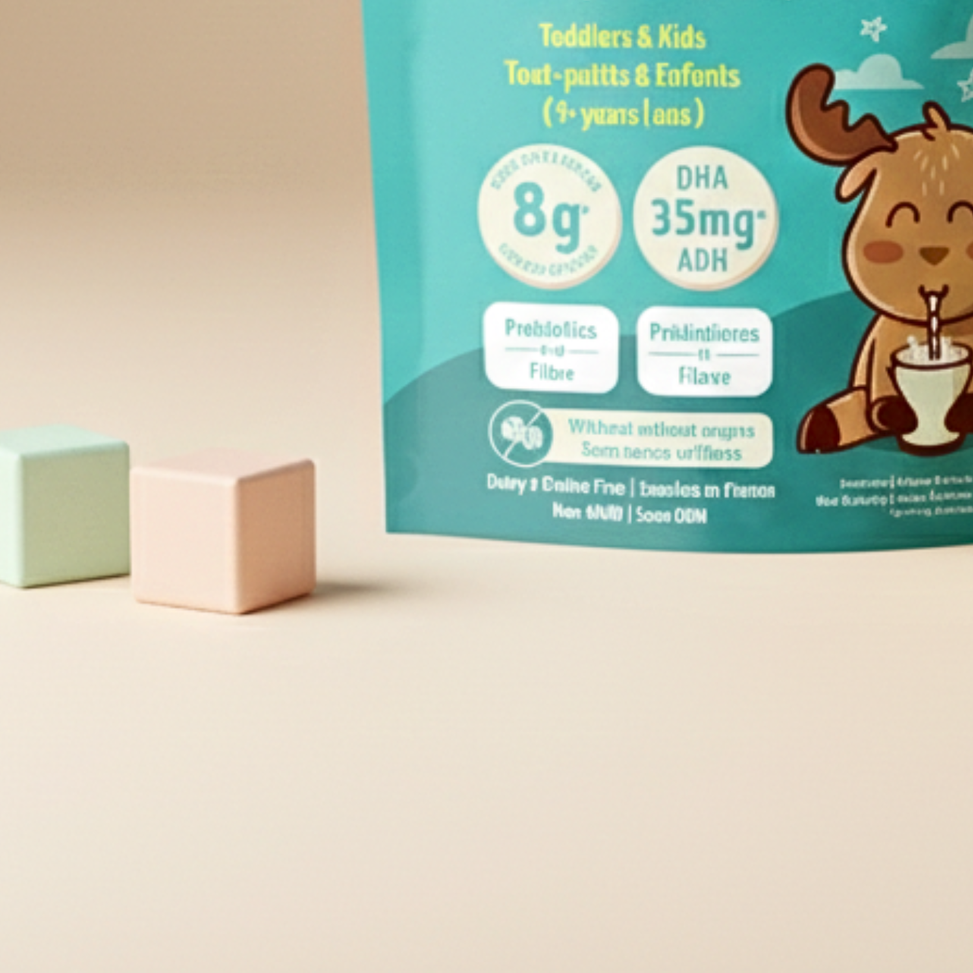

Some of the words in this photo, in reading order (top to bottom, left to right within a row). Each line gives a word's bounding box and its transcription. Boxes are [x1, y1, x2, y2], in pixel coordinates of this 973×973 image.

[637, 24, 653, 49] &
[658, 24, 707, 49] Kids
[635, 63, 650, 88] &
[677, 165, 728, 191] DHA
[677, 247, 728, 273] ADH
